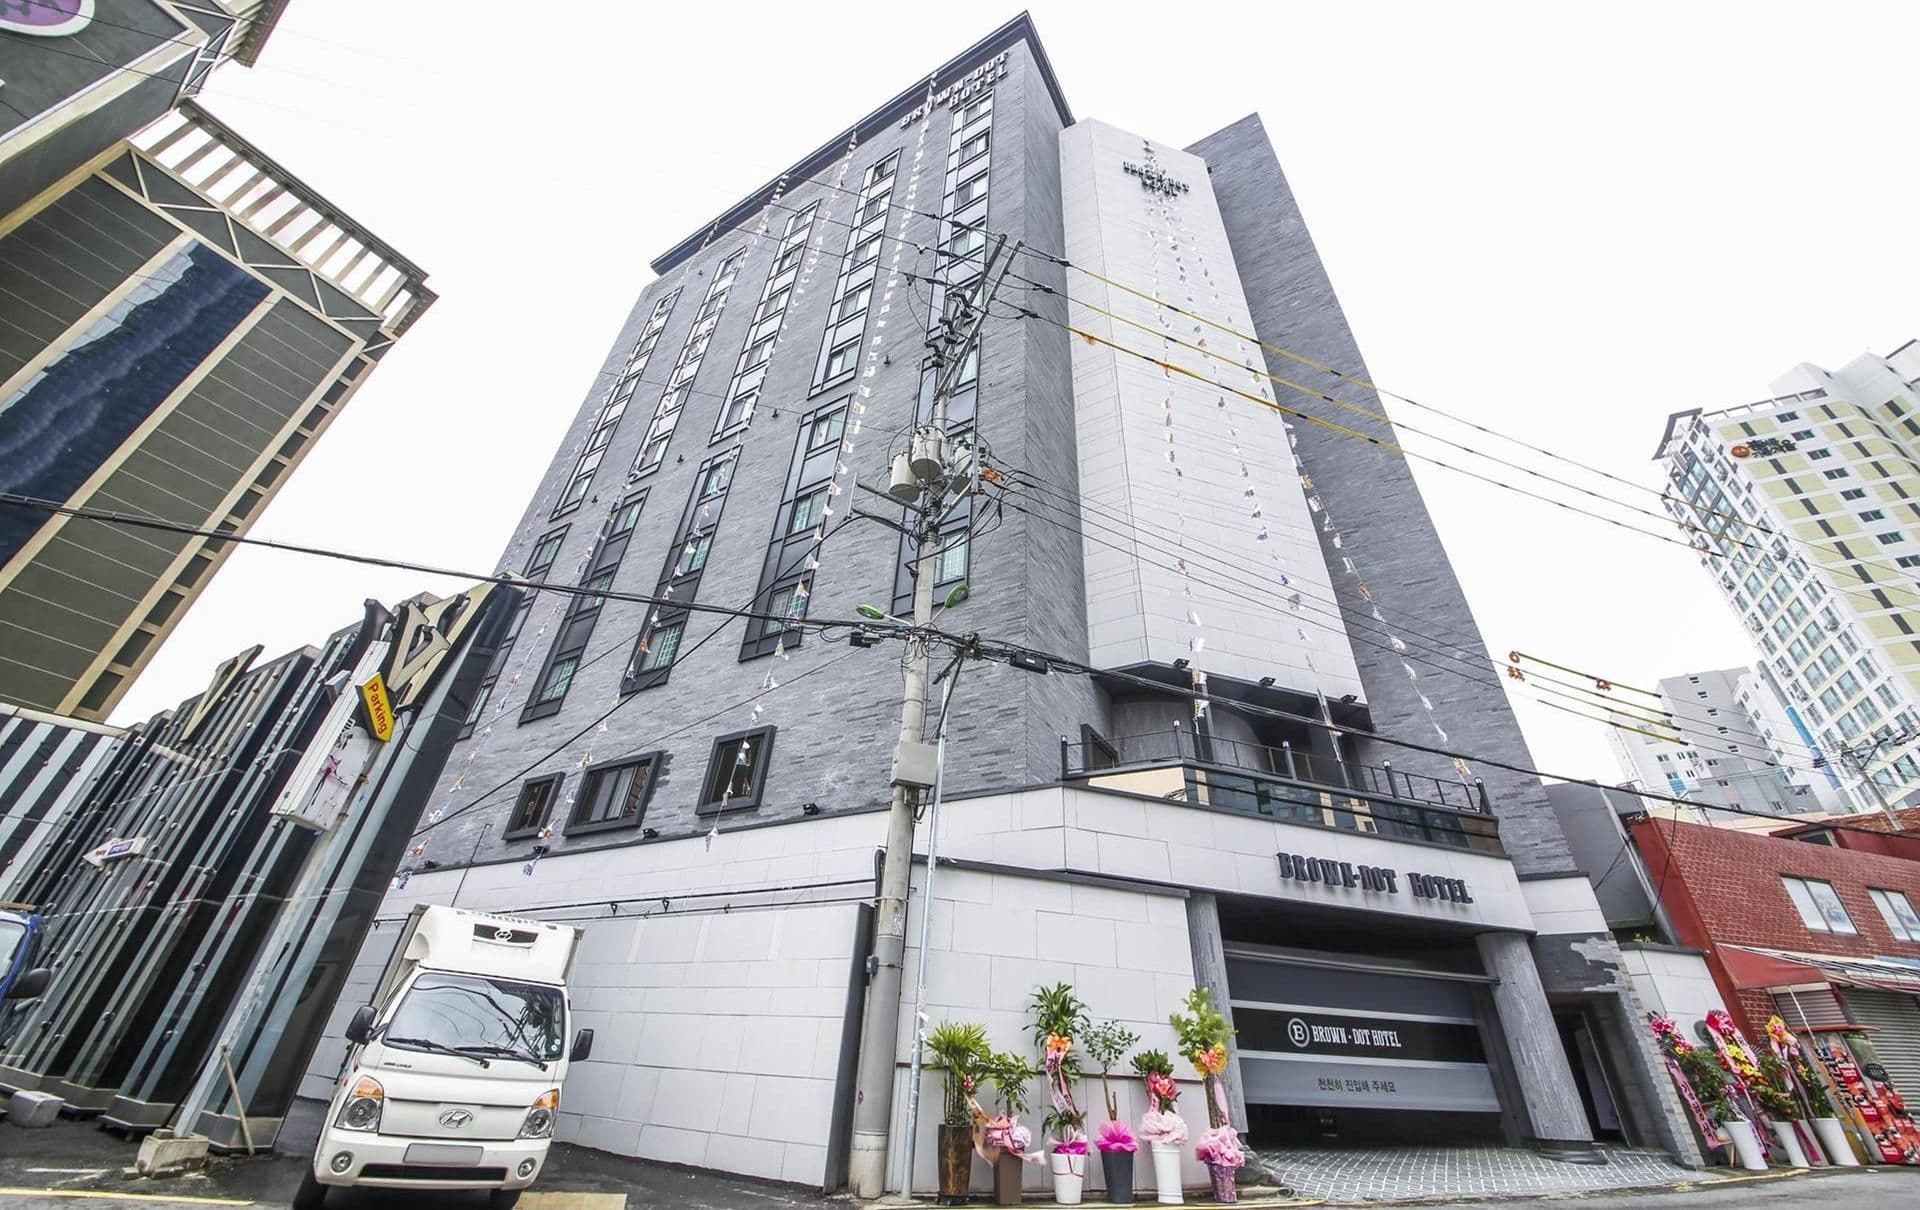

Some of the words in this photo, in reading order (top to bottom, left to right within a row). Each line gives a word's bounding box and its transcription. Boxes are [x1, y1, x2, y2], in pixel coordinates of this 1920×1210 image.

[368, 682, 388, 734] Parking
[1277, 852, 1399, 893] BROWN-DOT
[1408, 872, 1473, 903] HOTEL
[1371, 1030, 1402, 1047] HOTEL
[1318, 1078, 1343, 1092] 천천히
[1372, 1080, 1397, 1093] 주세요
